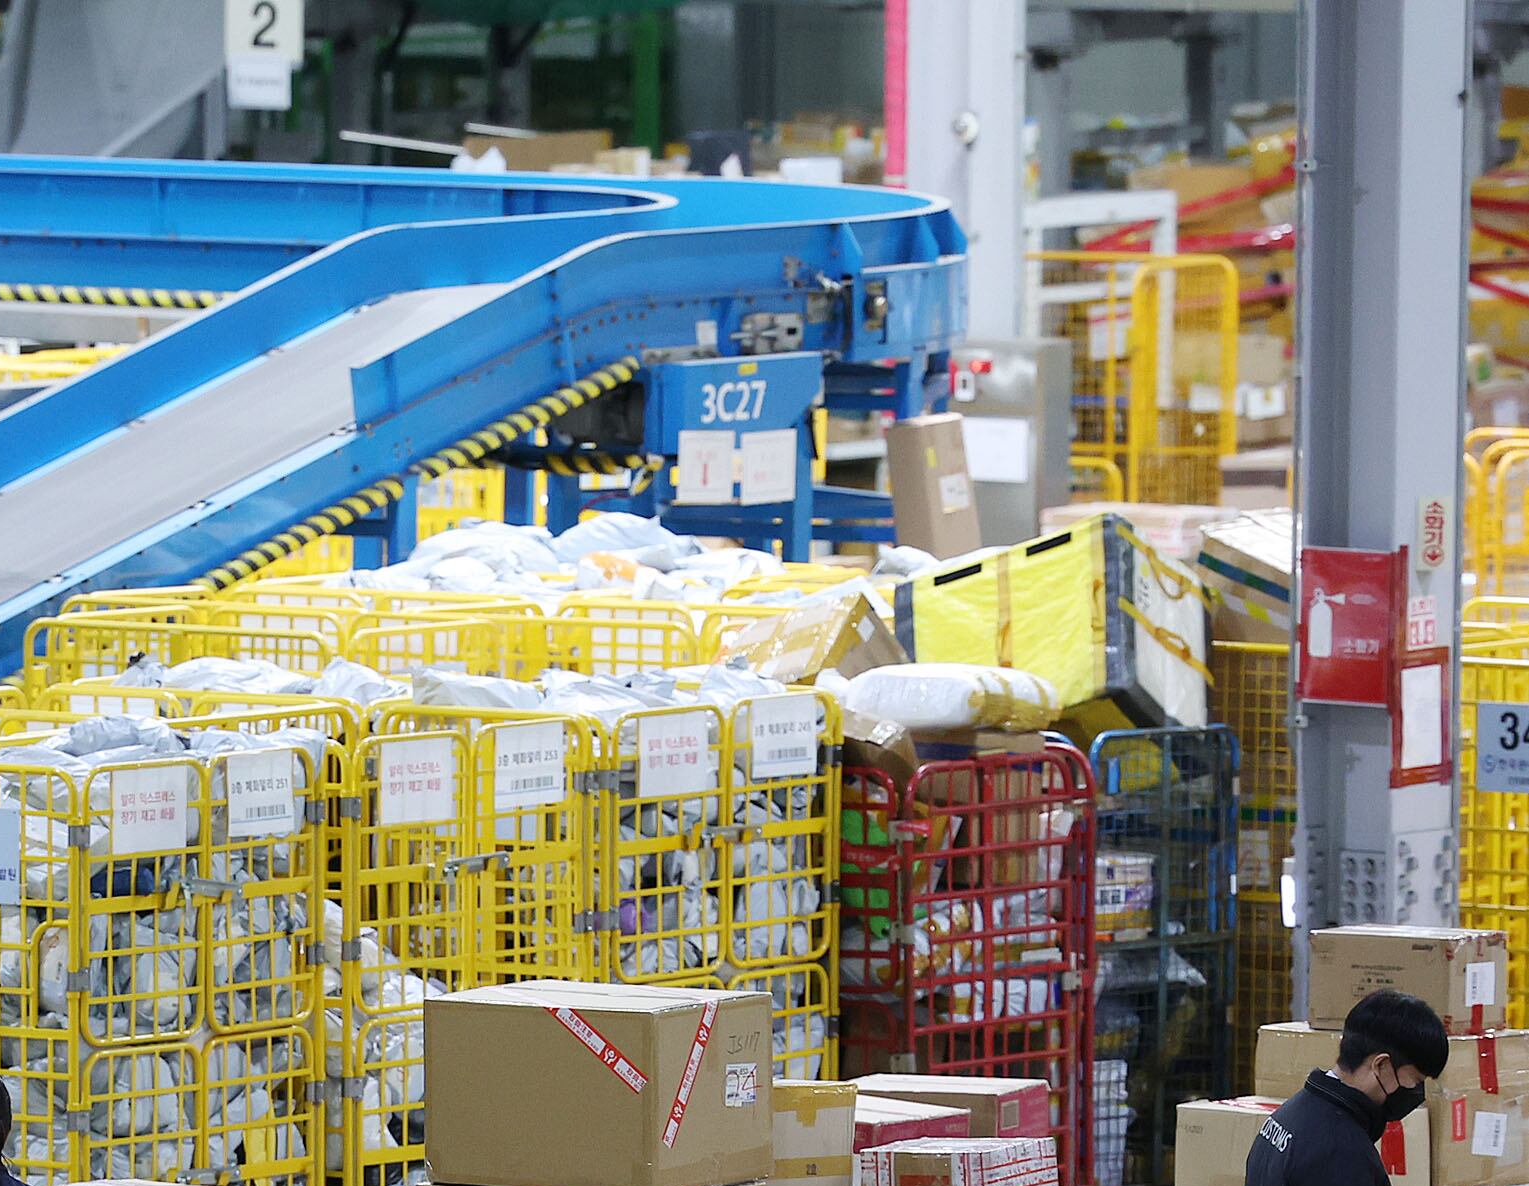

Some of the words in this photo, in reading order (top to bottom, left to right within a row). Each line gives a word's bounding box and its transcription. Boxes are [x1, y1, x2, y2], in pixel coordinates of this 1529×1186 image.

[251, 2, 277, 47] 2
[701, 381, 767, 423] 3C27
[1425, 501, 1444, 546] 소화기
[276, 778, 289, 789] 251
[141, 809, 156, 821] 재고
[1260, 1116, 1293, 1153] CUSTOMS
